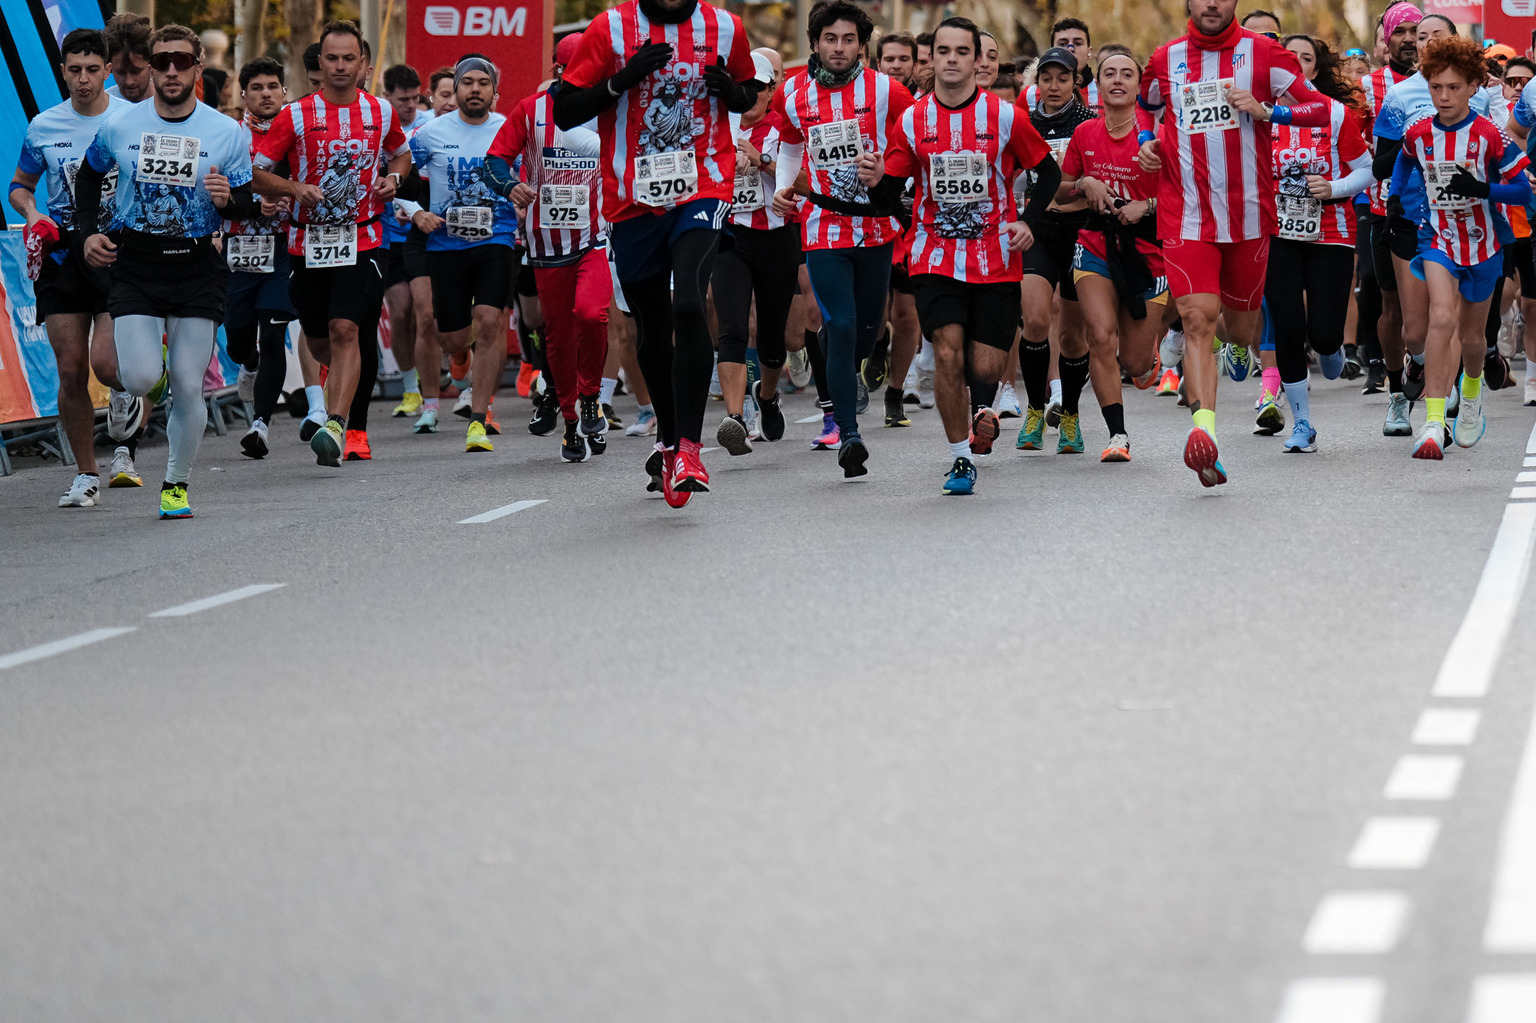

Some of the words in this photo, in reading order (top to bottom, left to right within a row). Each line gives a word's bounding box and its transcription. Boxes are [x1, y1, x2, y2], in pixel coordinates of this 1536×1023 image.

[463, 7, 527, 37] BM
[1190, 105, 1231, 124] 2218
[818, 144, 858, 162] 4415
[142, 158, 193, 178] 3234
[544, 160, 596, 170] Plus500
[649, 178, 687, 197] 570
[935, 179, 984, 194] 5586
[549, 208, 579, 221] 975
[313, 245, 350, 260] 3714
[231, 255, 270, 268] 2307
